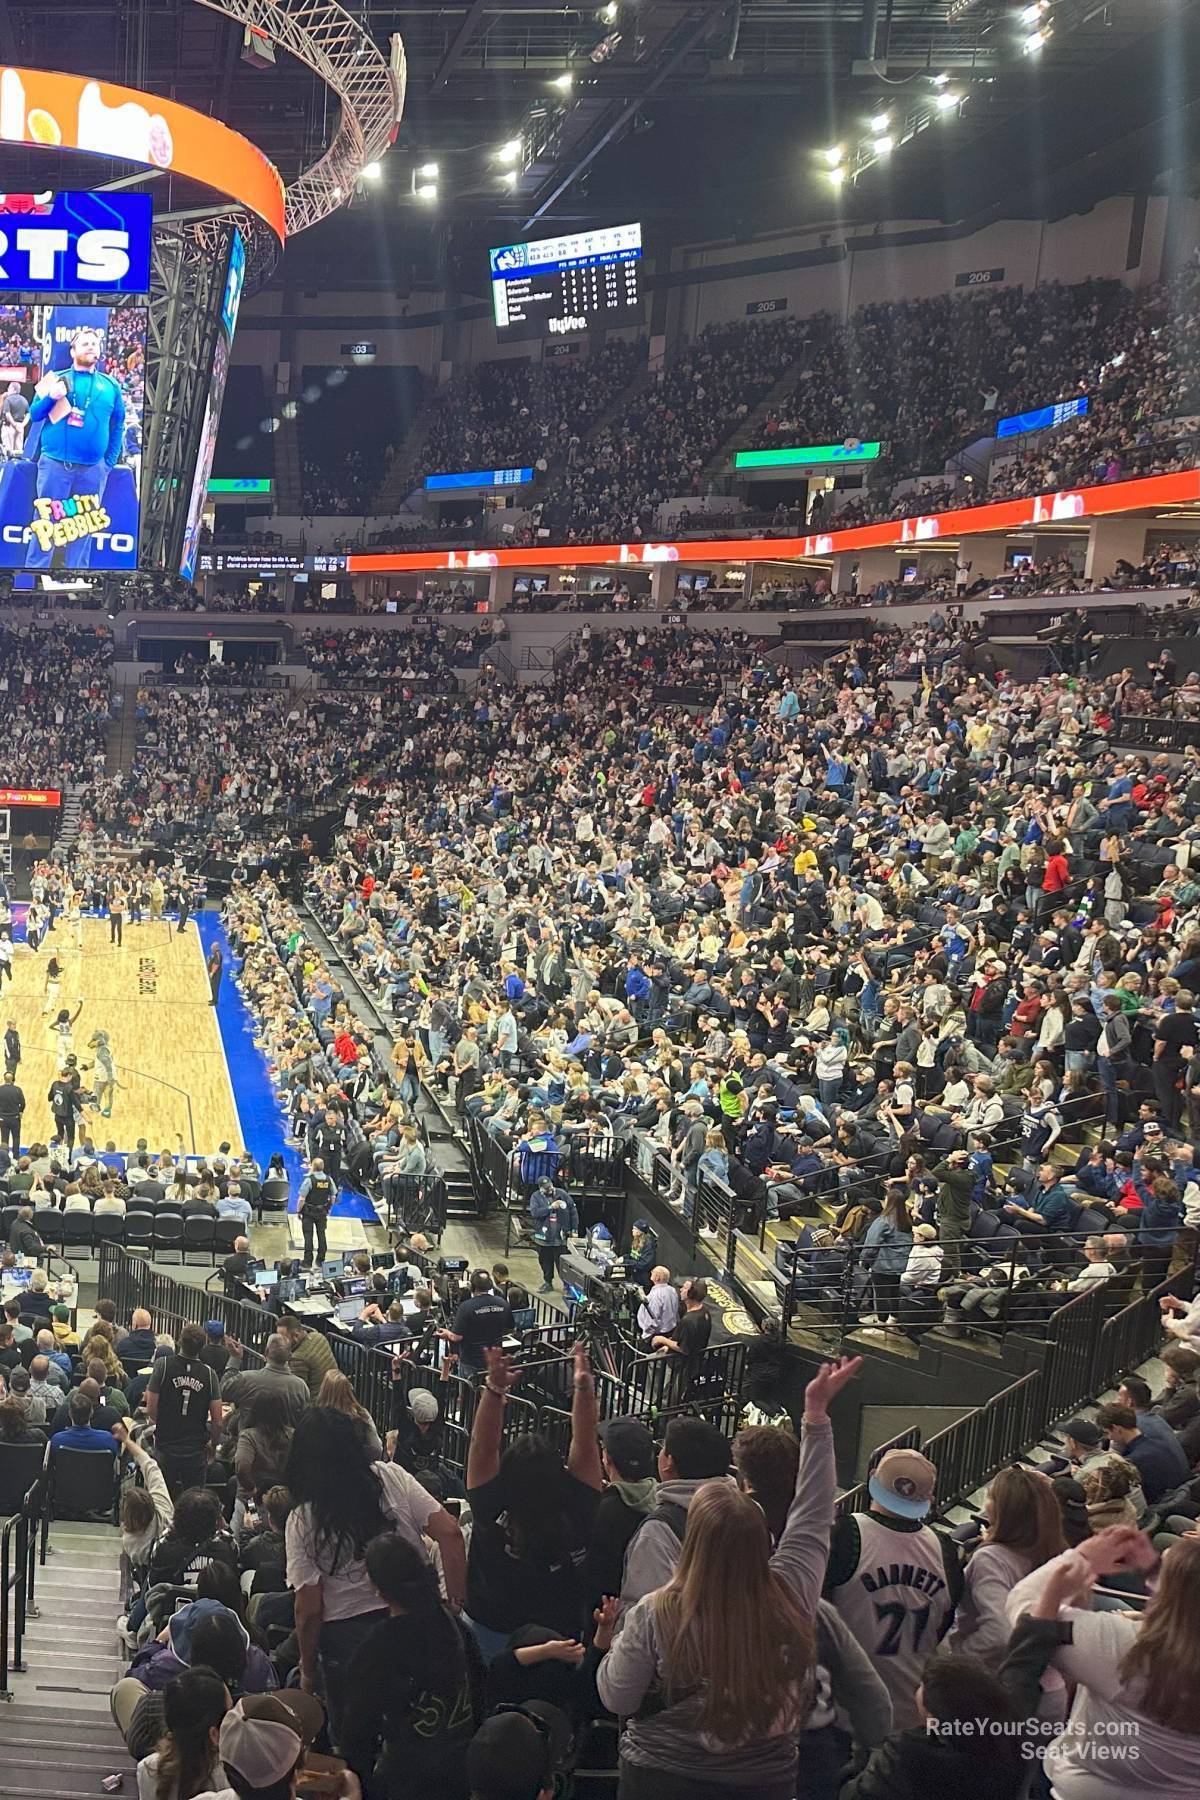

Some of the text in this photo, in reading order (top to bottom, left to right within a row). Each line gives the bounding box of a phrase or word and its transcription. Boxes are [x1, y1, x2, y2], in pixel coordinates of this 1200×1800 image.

[969, 272, 991, 284] 206
[757, 301, 776, 313] 205
[350, 346, 367, 354] 203
[30, 508, 111, 552] PEBBLES
[1050, 616, 1061, 626] 110
[1022, 1125, 1031, 1138] 32
[172, 1376, 204, 1392] EDWARDS
[182, 1390, 190, 1415] 1
[861, 1564, 946, 1597] GARNETT
[874, 1600, 932, 1655] 21
